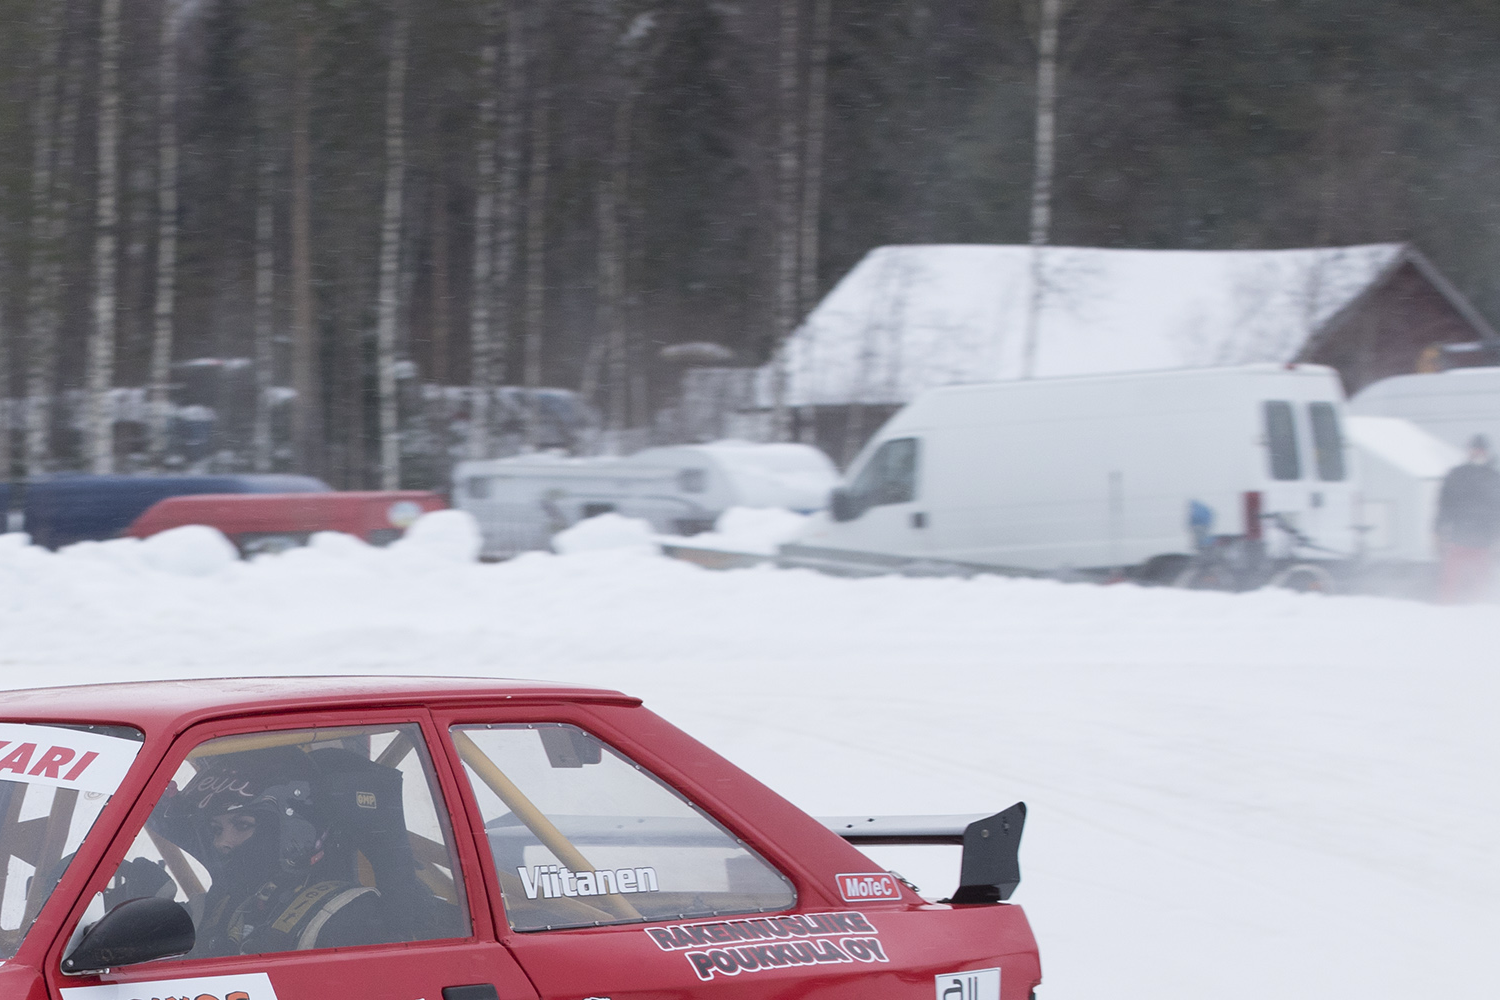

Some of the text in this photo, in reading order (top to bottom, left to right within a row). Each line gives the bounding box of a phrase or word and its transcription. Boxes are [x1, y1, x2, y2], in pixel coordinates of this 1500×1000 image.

[516, 865, 659, 900] Viitanen
[845, 877, 893, 898] MoTeC
[646, 912, 877, 950] RAKENNUSLIIKE
[686, 938, 888, 980] POUKKULA OY
